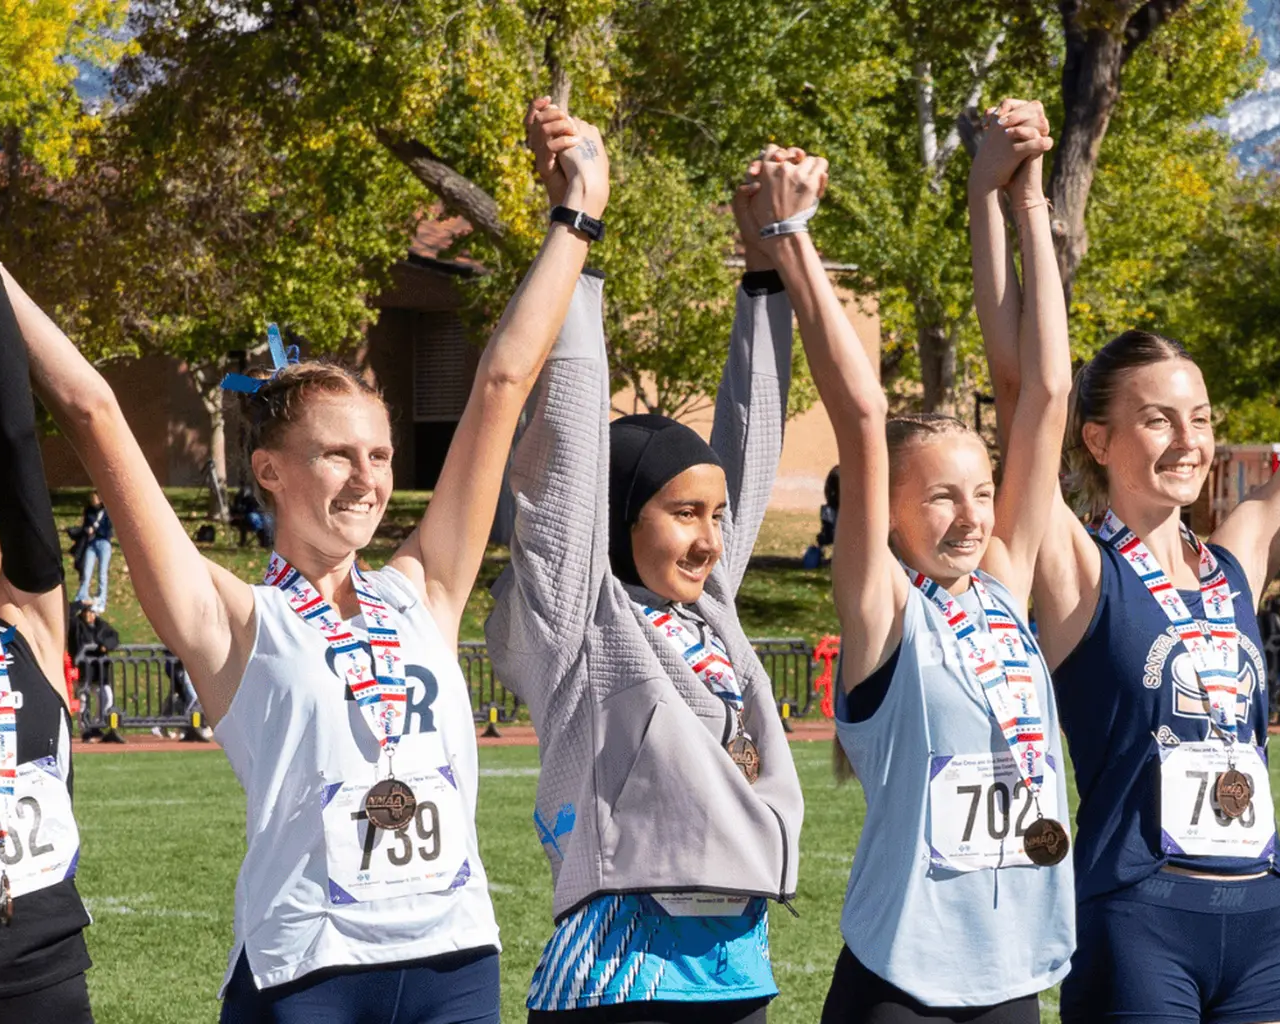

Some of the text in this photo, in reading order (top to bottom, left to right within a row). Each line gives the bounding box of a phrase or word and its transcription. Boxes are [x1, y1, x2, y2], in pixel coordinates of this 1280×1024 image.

[367, 795, 402, 807] NMAA
[957, 779, 1034, 842] 702
[350, 800, 441, 871] 739
